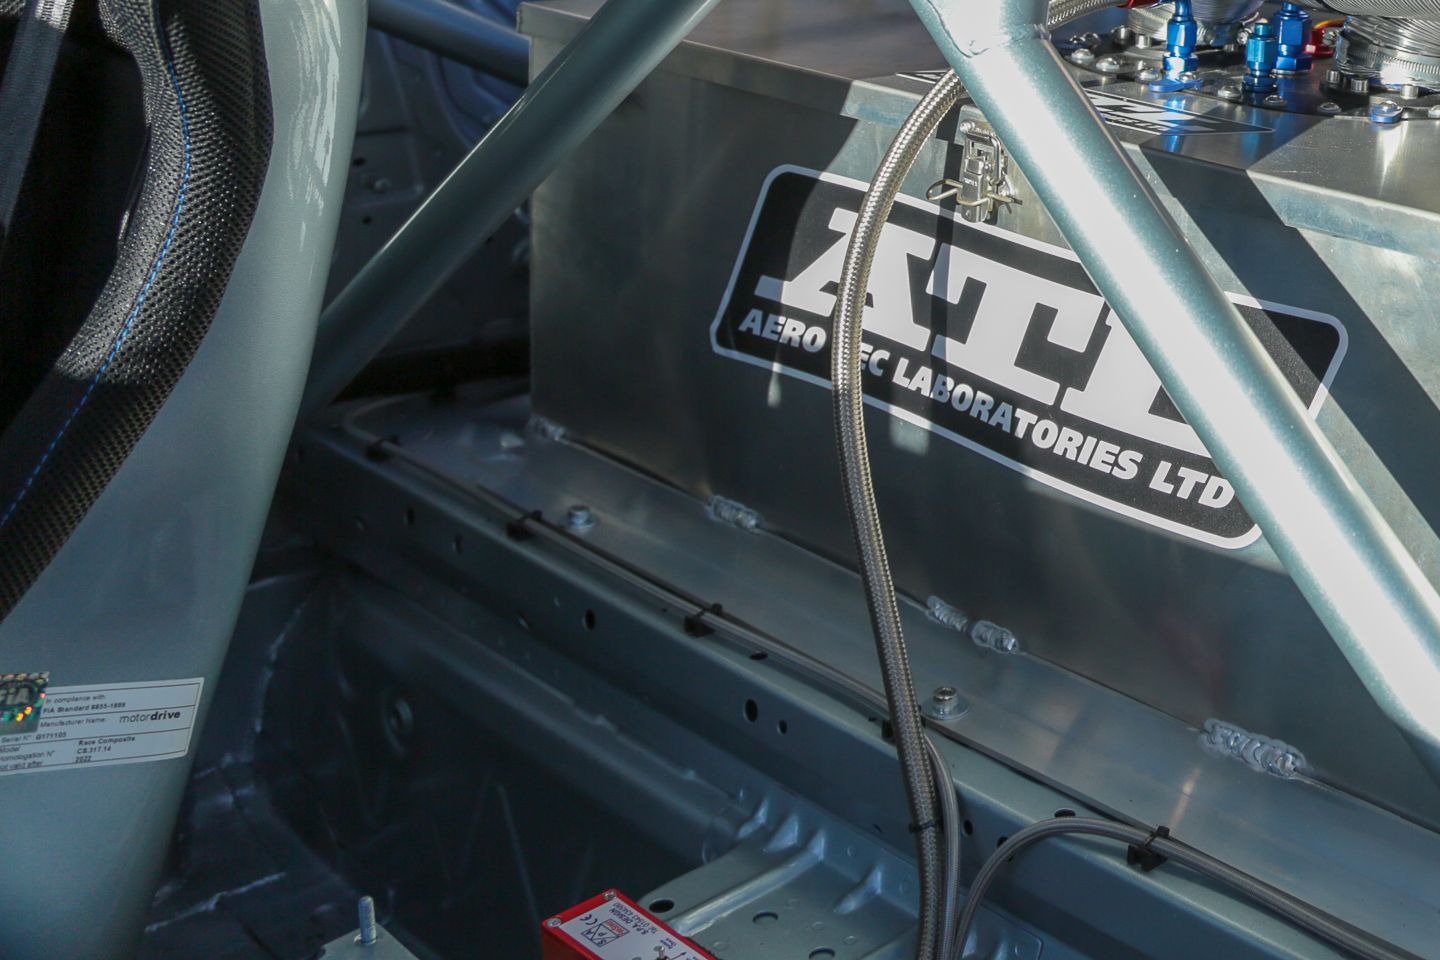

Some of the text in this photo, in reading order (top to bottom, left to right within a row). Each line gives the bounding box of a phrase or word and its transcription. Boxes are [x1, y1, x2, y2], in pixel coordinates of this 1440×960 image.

[738, 308, 827, 353] AERO
[892, 358, 1144, 480] LABORATORIES
[1149, 461, 1235, 509] LTD
[57, 705, 90, 713] Standard
[119, 710, 181, 723] motordrive
[98, 736, 135, 744] Composite
